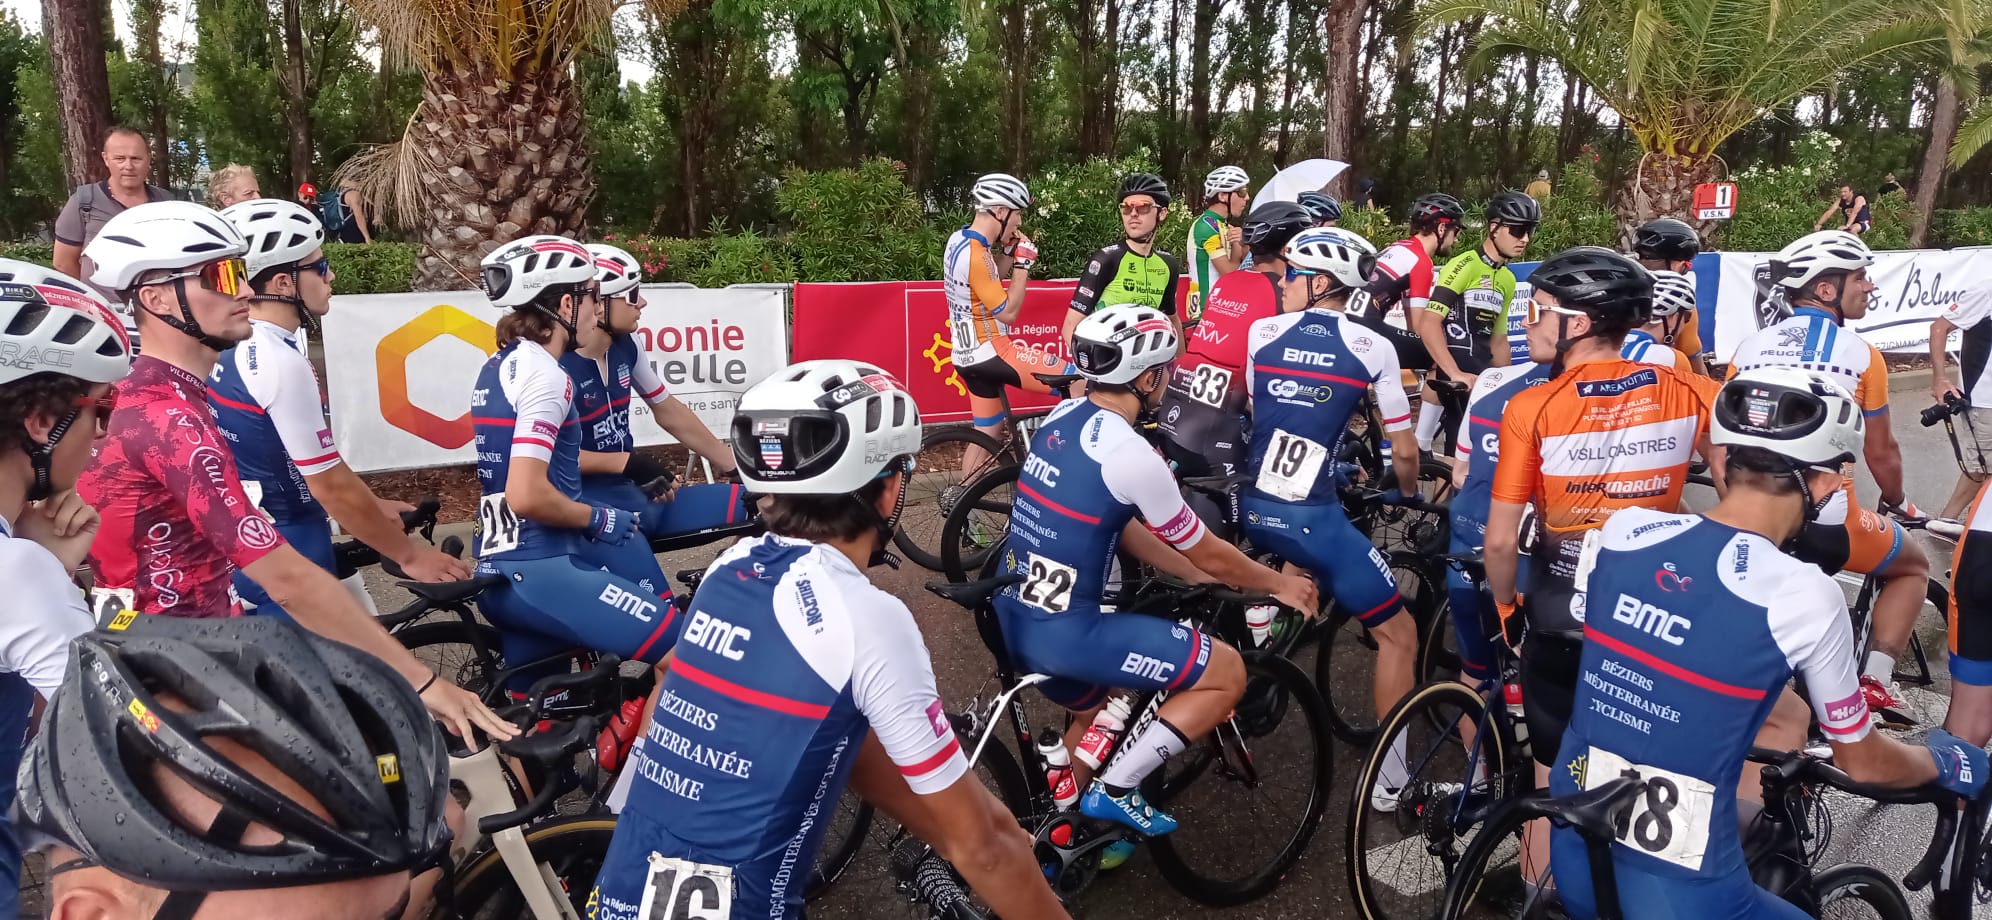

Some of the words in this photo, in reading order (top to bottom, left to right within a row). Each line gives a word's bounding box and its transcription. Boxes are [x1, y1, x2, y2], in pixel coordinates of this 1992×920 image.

[1721, 187, 1727, 205] 1
[1136, 284, 1164, 295] Montauba
[1758, 272, 1771, 280] PE
[637, 319, 744, 352] onie
[1009, 326, 1021, 335] La
[1023, 324, 1057, 336] Région
[1299, 324, 1334, 336] VIDAL
[1283, 348, 1336, 367] BMC
[1760, 349, 1824, 357] PEUGEOT
[650, 354, 747, 385] elle
[1600, 371, 1654, 392] AREATONIC
[1192, 366, 1228, 405] 33
[1298, 385, 1320, 394] BIKE
[634, 406, 650, 416] av
[688, 401, 707, 411] tre
[711, 398, 739, 410] sant
[1271, 435, 1308, 478] 19
[1568, 447, 1605, 461] VSLL
[1608, 436, 1677, 457] CASTRES
[1023, 452, 1060, 487] BMC
[483, 498, 515, 547] 24
[1016, 496, 1041, 518] BÉZIERS
[1010, 523, 1041, 547] CYCLISME
[1632, 519, 1683, 538] SHILTON
[1368, 547, 1396, 588] BMC
[1734, 542, 1750, 574] SHILTON
[1022, 560, 1071, 612] 22
[599, 583, 657, 623] BMC
[796, 577, 823, 627] SHILTON
[1613, 593, 1691, 646] BMC
[684, 610, 751, 661] BMC
[1120, 652, 1176, 683] BMC
[1601, 659, 1654, 692] BÉZIERS
[659, 689, 718, 731] BÉZIERS
[1584, 670, 1681, 723] MÉDITERRANÉE
[1615, 768, 1679, 852] 18
[603, 894, 610, 905] La
[610, 897, 638, 914] Région
